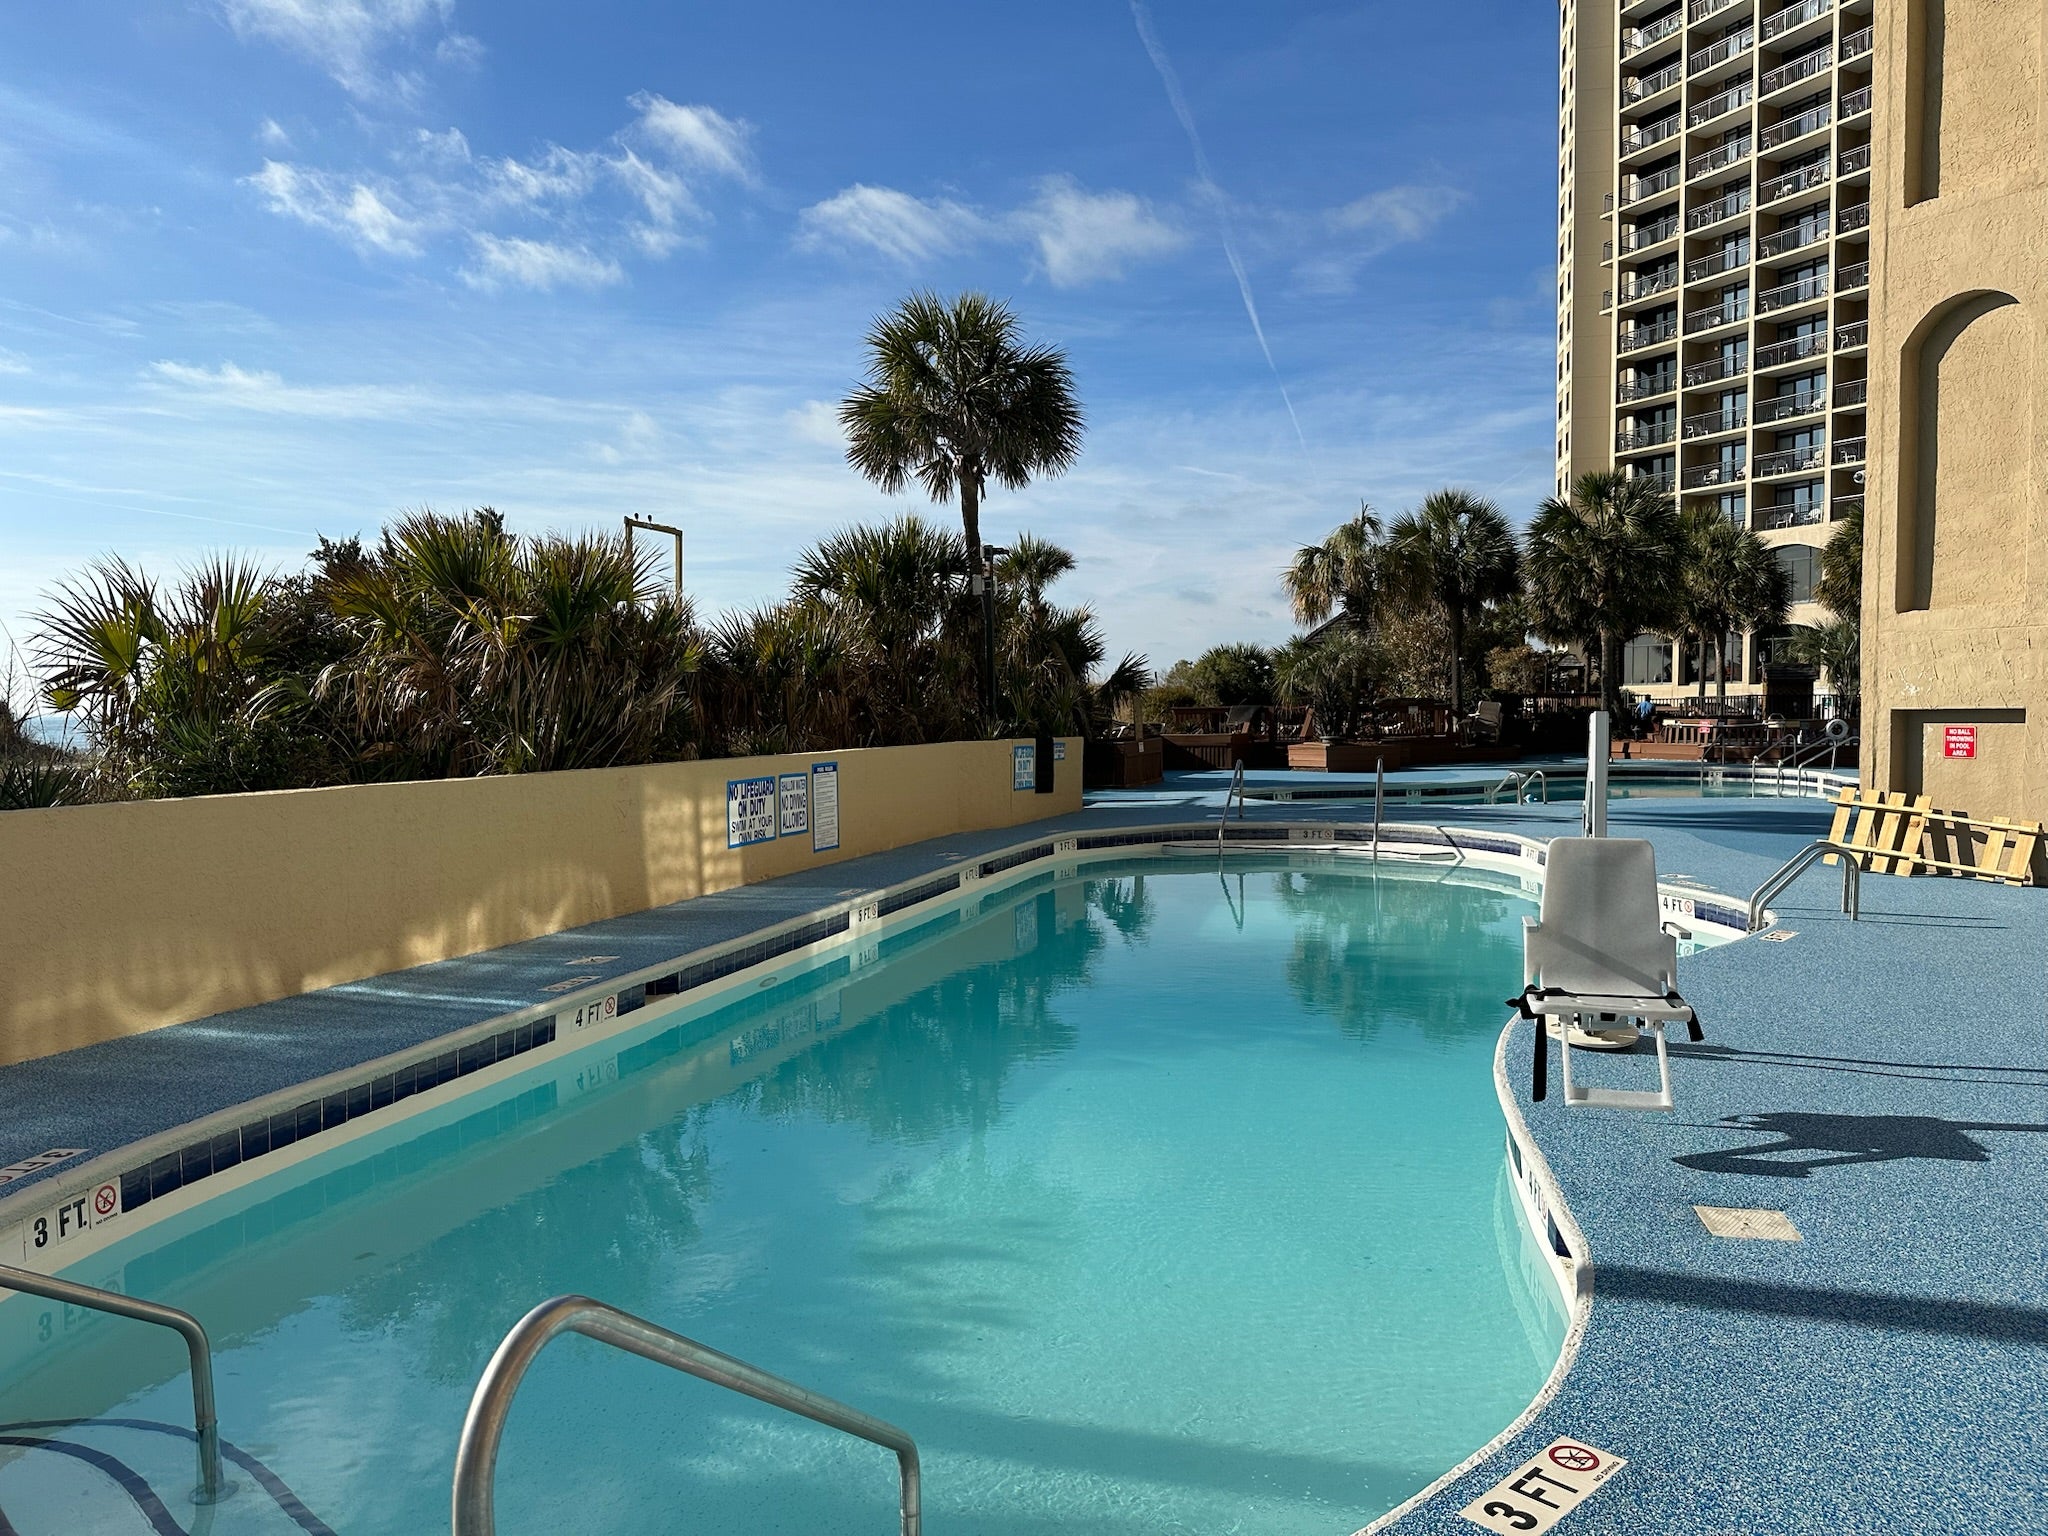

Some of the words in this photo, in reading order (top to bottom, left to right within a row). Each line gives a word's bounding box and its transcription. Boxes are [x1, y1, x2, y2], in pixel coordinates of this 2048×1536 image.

[728, 783, 739, 801] NO
[741, 780, 774, 799] LIFEGUARD
[738, 800, 747, 818] ON
[750, 798, 766, 816] DUTY
[782, 794, 788, 811] NO
[790, 792, 806, 810] DIVING
[732, 819, 746, 833] SWIM
[749, 818, 755, 830] AT
[758, 815, 773, 828] YOUR
[782, 810, 805, 830] ALLOWED
[738, 832, 752, 843] OWN
[754, 828, 766, 840] RISK
[1303, 830, 1308, 839] 3
[1663, 897, 1668, 909] 4
[576, 1008, 582, 1027] 4
[588, 1002, 602, 1024] FT
[4, 1162, 52, 1173] FT
[34, 1217, 48, 1248] 3
[59, 1198, 87, 1238] FT.
[1593, 1474, 1604, 1482] NO
[1604, 1461, 1620, 1476] DIVING
[1508, 1466, 1579, 1510] FT
[1484, 1501, 1538, 1530] 3
